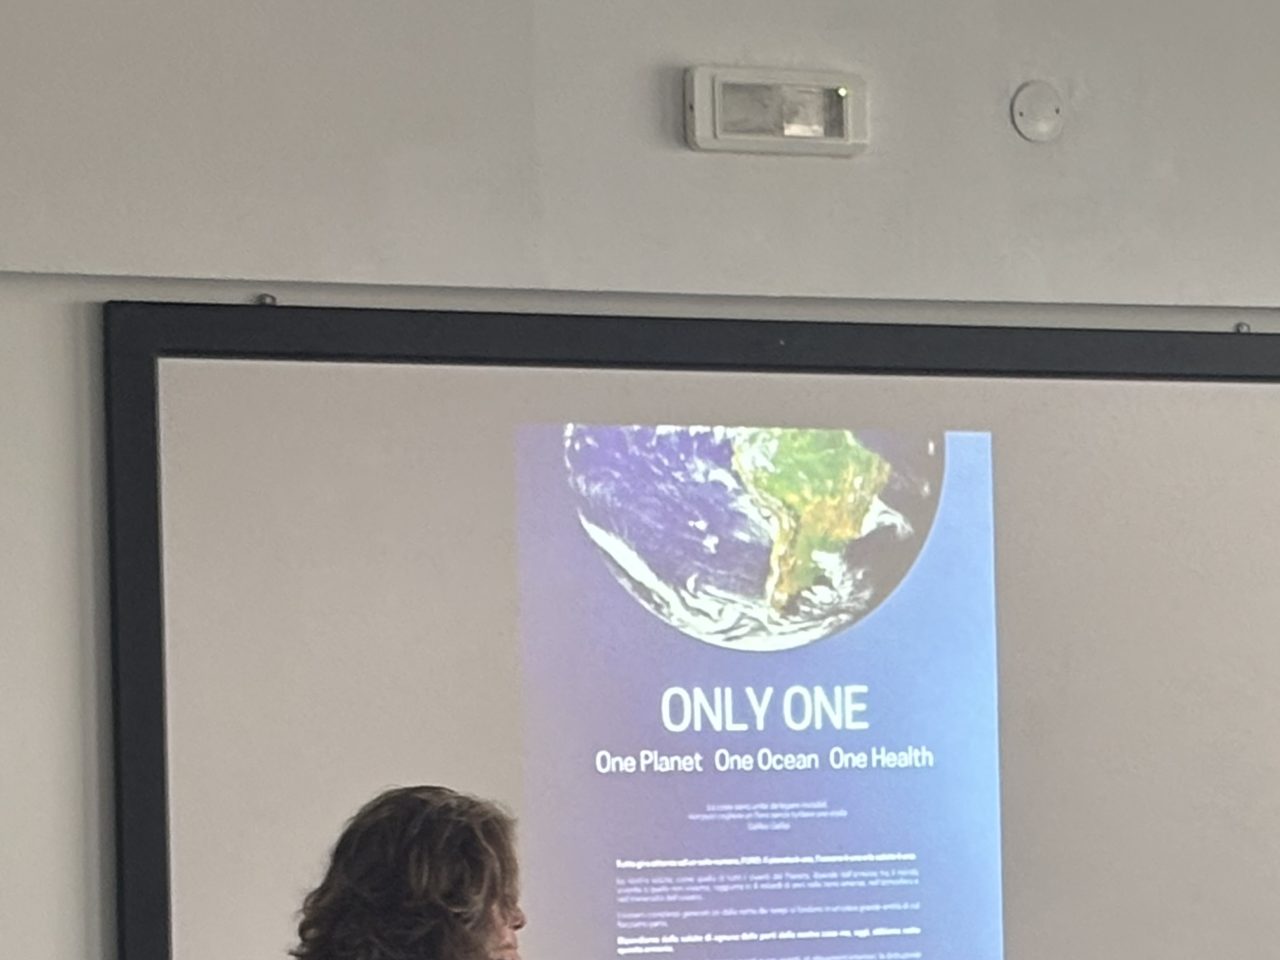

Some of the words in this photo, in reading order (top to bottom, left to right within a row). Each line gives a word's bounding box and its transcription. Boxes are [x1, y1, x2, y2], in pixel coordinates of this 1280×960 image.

[661, 686, 774, 732] ONLY
[783, 684, 870, 731] ONE
[595, 750, 637, 773] One
[639, 749, 704, 773] Planet
[714, 748, 754, 771] One
[757, 747, 820, 771] Ocean
[829, 746, 868, 770] One
[871, 745, 934, 768] Health
